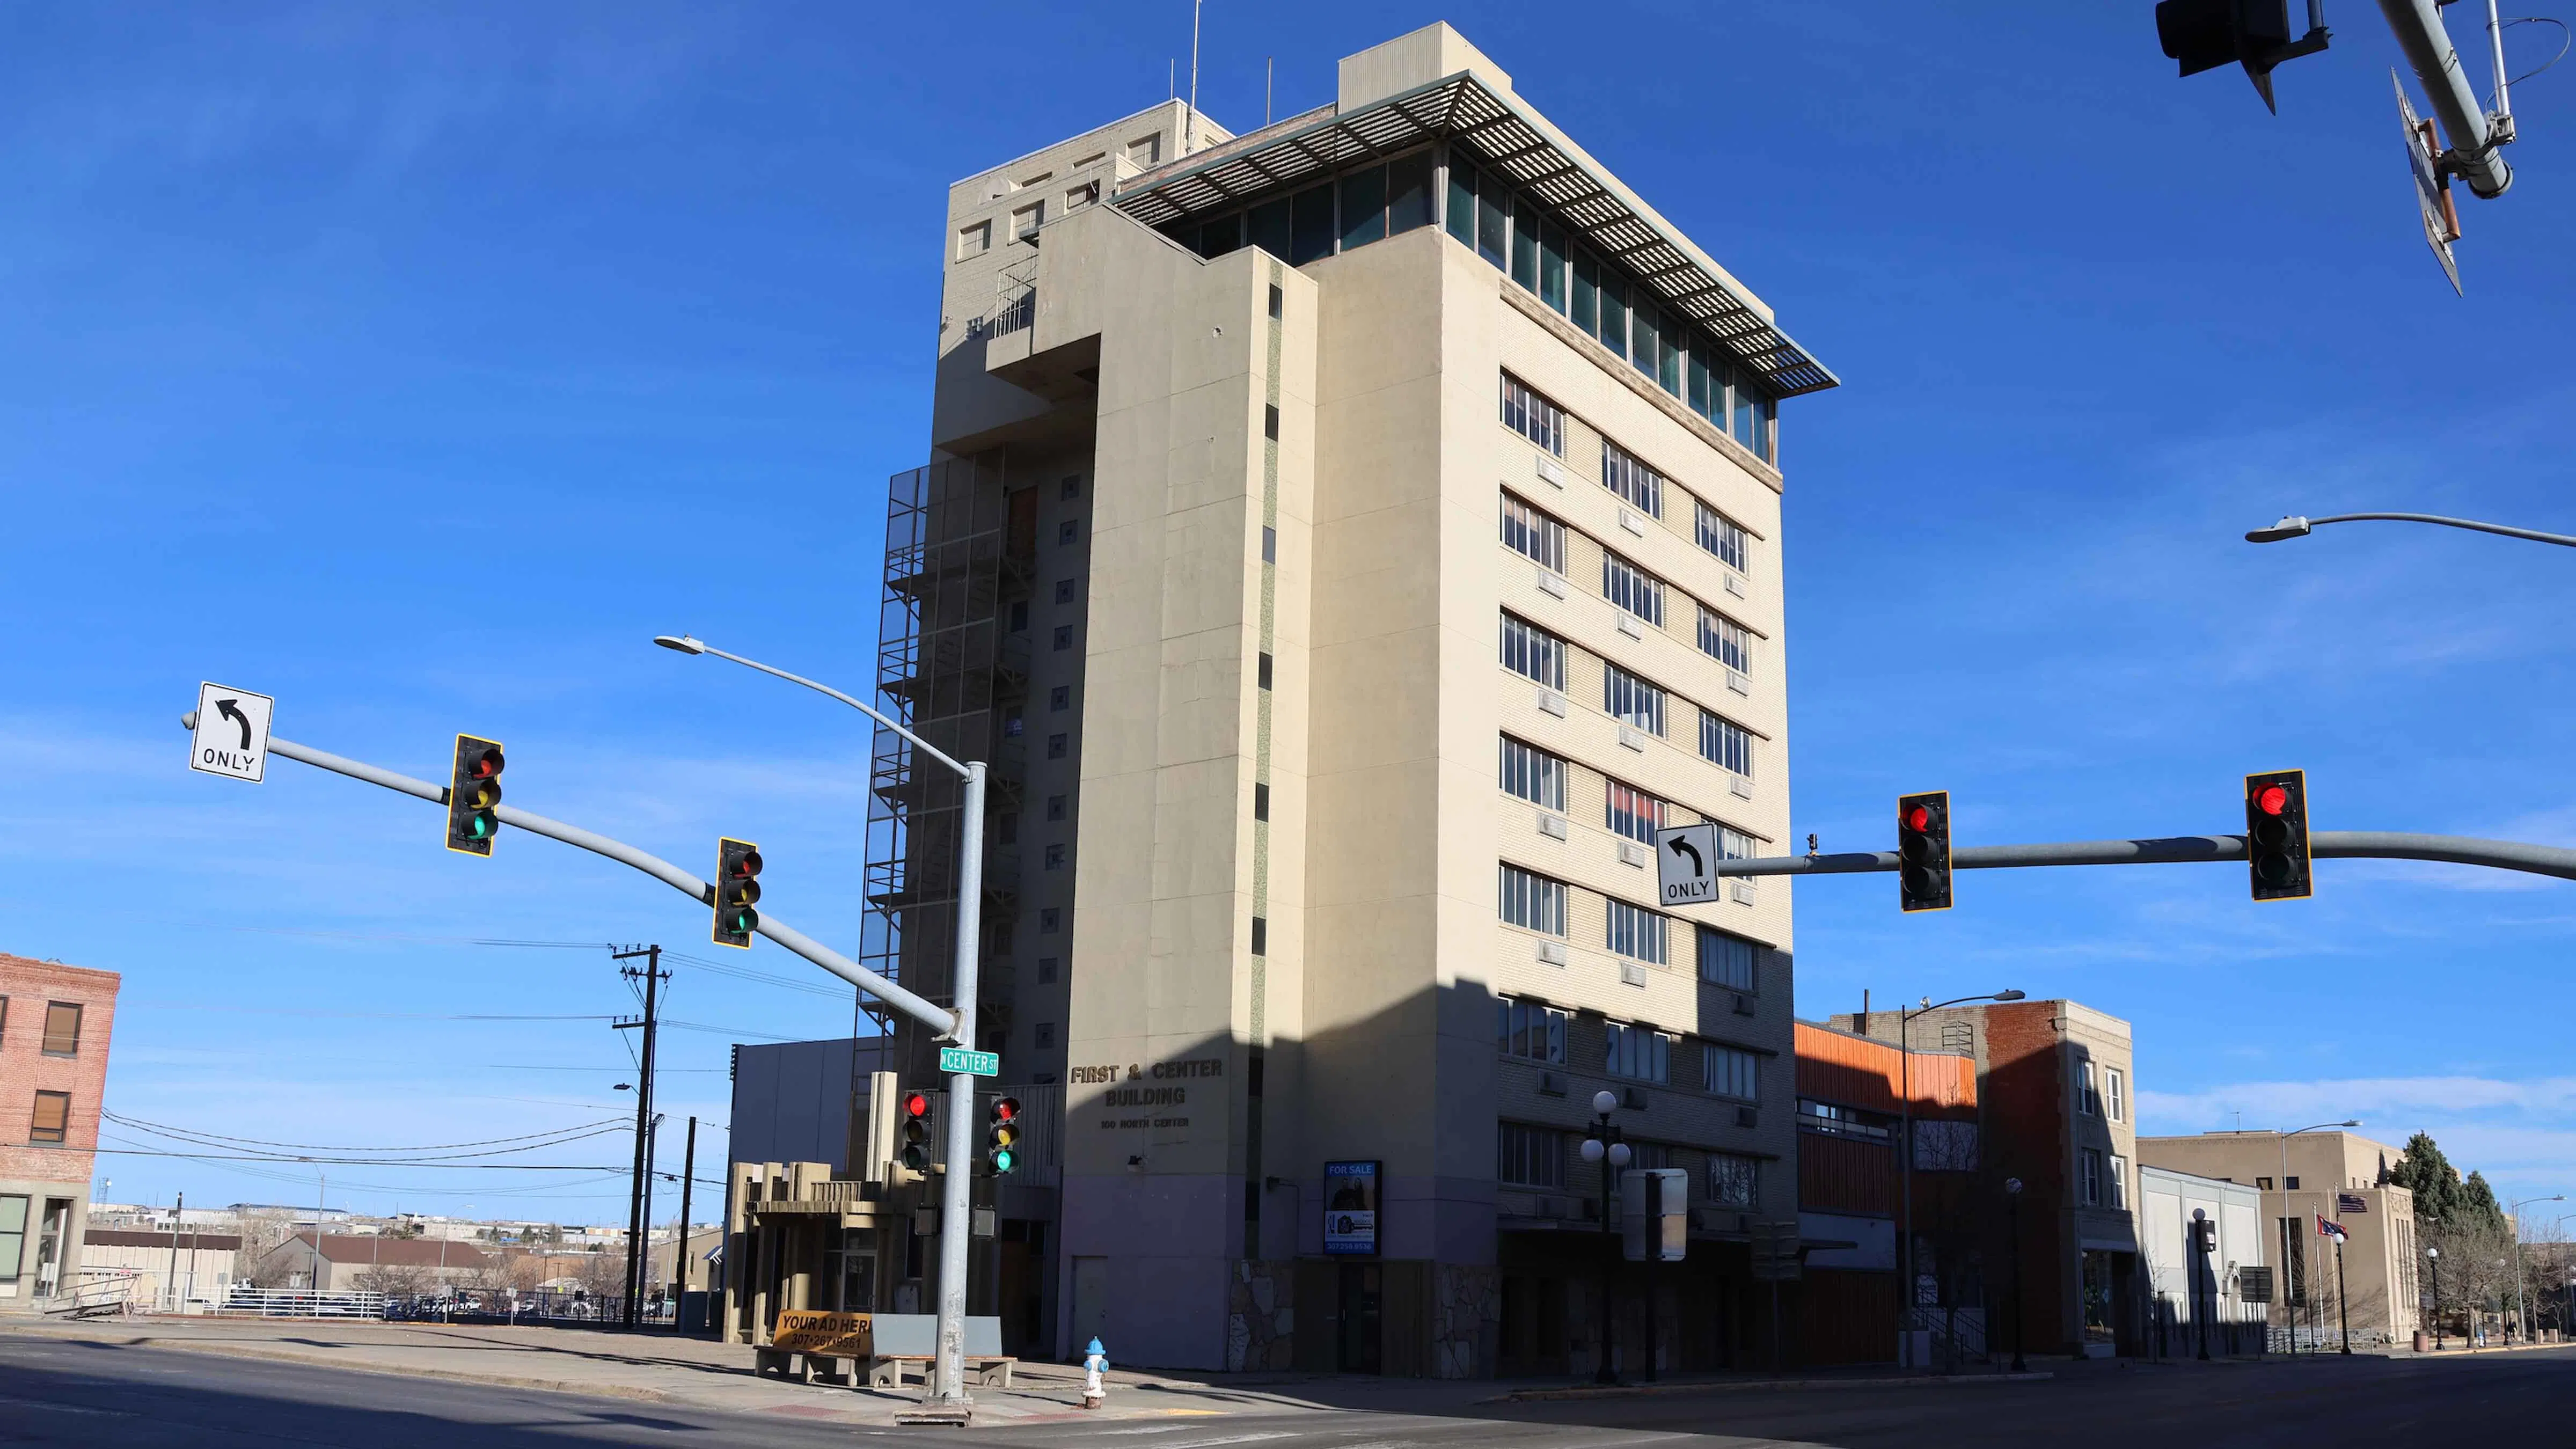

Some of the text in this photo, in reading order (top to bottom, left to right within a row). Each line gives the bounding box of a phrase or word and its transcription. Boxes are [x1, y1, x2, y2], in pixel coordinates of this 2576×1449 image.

[203, 748, 255, 771] ONLY
[1668, 881, 1709, 898] ONLY
[947, 1052, 987, 1072] CENTER
[989, 1059, 997, 1070] ST
[1071, 1059, 1223, 1084] FIRST & CENTER
[1105, 1087, 1185, 1107] BUILDING
[1120, 1118, 1149, 1129] NORTH
[1154, 1117, 1189, 1128] CENTER
[1329, 1165, 1372, 1175] FOR SALE
[784, 1316, 817, 1330] YOUR
[818, 1318, 838, 1331] AD
